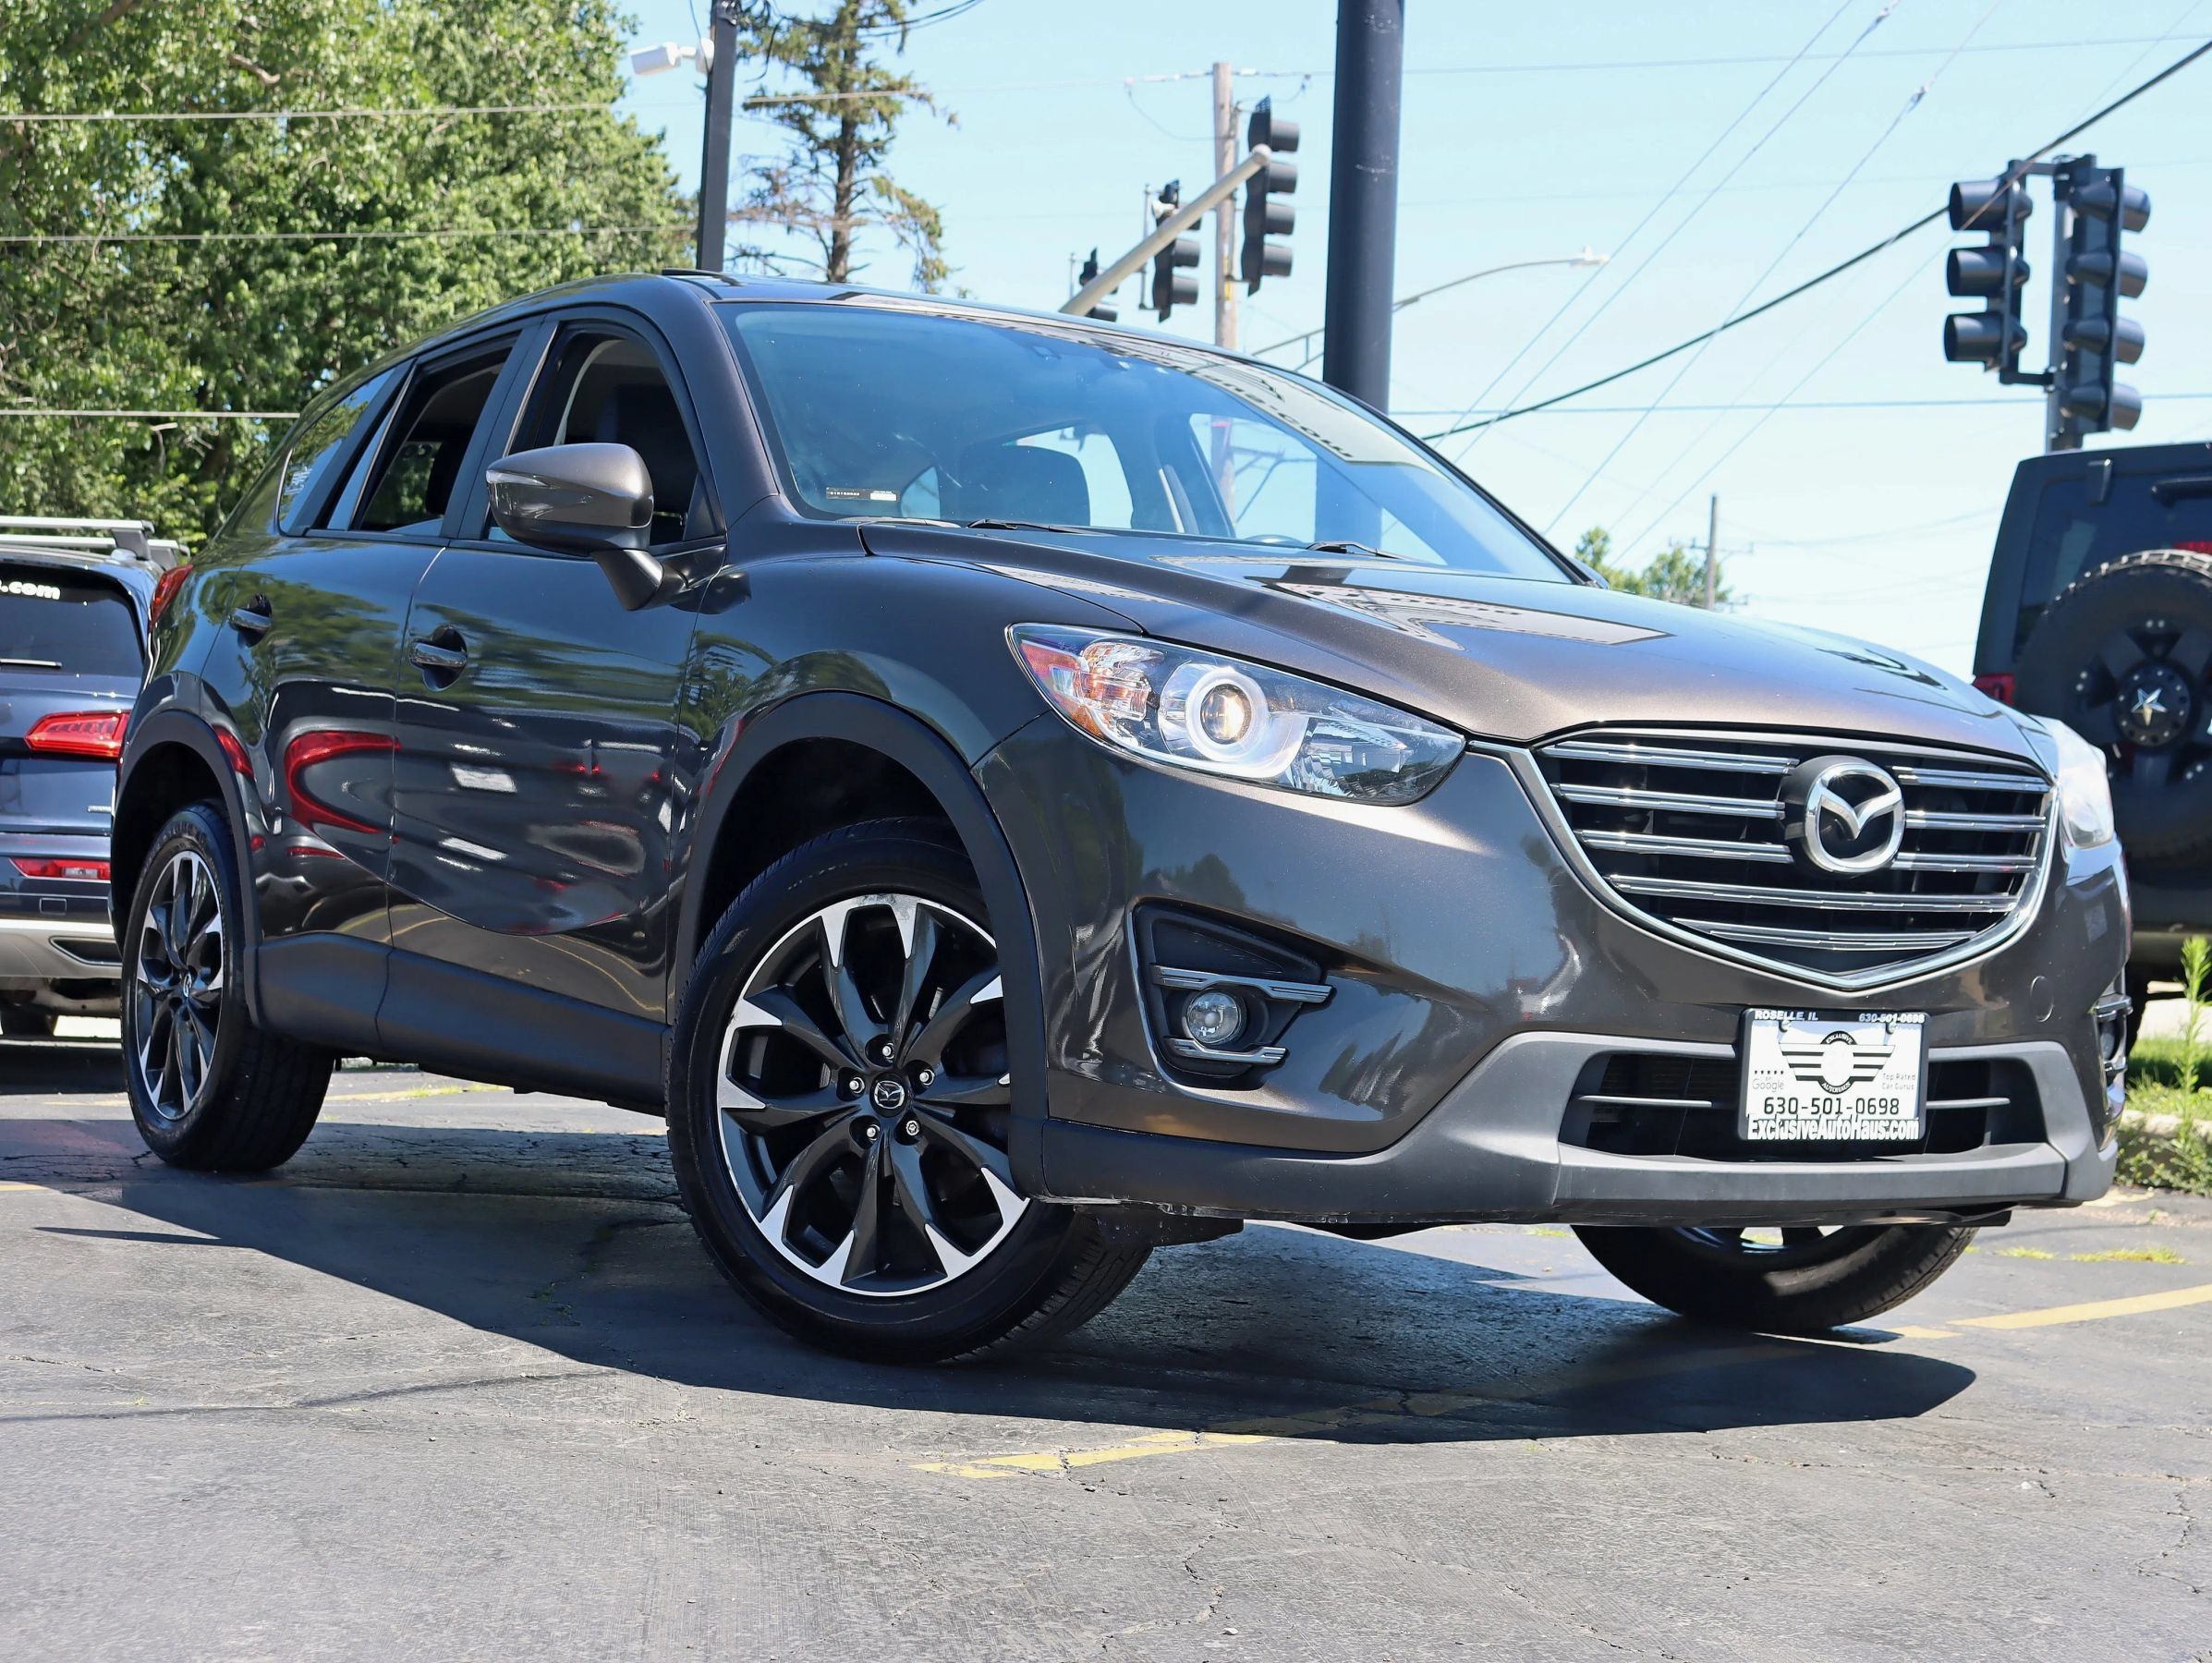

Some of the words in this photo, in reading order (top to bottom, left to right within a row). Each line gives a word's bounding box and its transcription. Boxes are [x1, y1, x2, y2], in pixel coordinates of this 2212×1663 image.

[0, 579, 61, 601] .com
[1807, 1012, 1818, 1021] IL
[1858, 1013, 1926, 1023] 630-501-0698
[1882, 1073, 1894, 1082] Top
[1895, 1073, 1916, 1081] Rated
[1752, 1078, 1784, 1092] Google
[1763, 1097, 1900, 1114] 630-501-0698
[1748, 1114, 1920, 1140] ExclusiveAutoHaus.com
